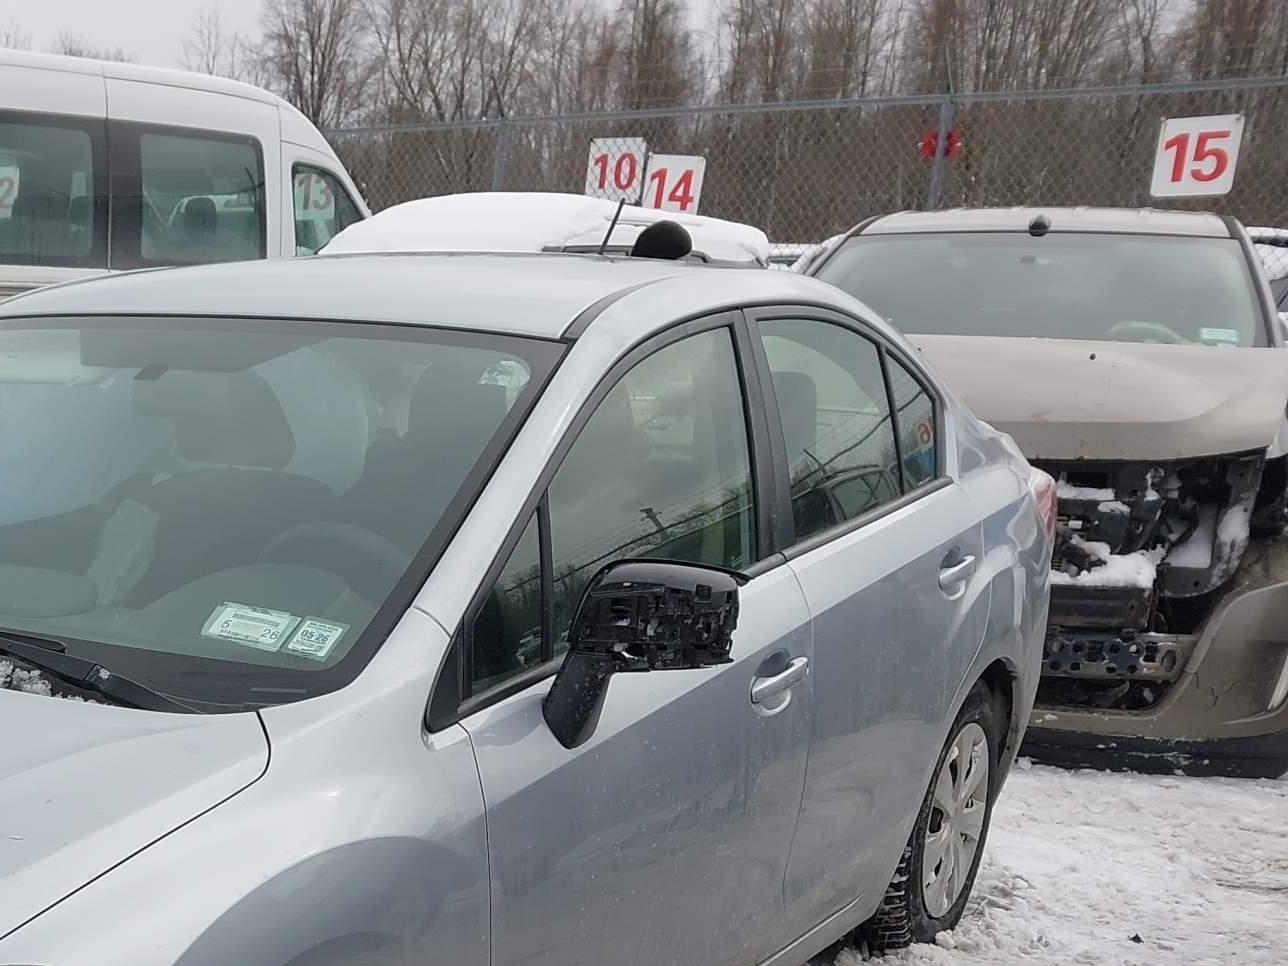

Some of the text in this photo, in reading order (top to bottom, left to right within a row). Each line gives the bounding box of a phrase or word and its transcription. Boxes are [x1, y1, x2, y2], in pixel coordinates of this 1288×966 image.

[593, 152, 637, 190] 10
[1164, 129, 1232, 183] 15
[298, 174, 332, 210] 13
[650, 167, 695, 211] 14
[259, 628, 280, 640] 26
